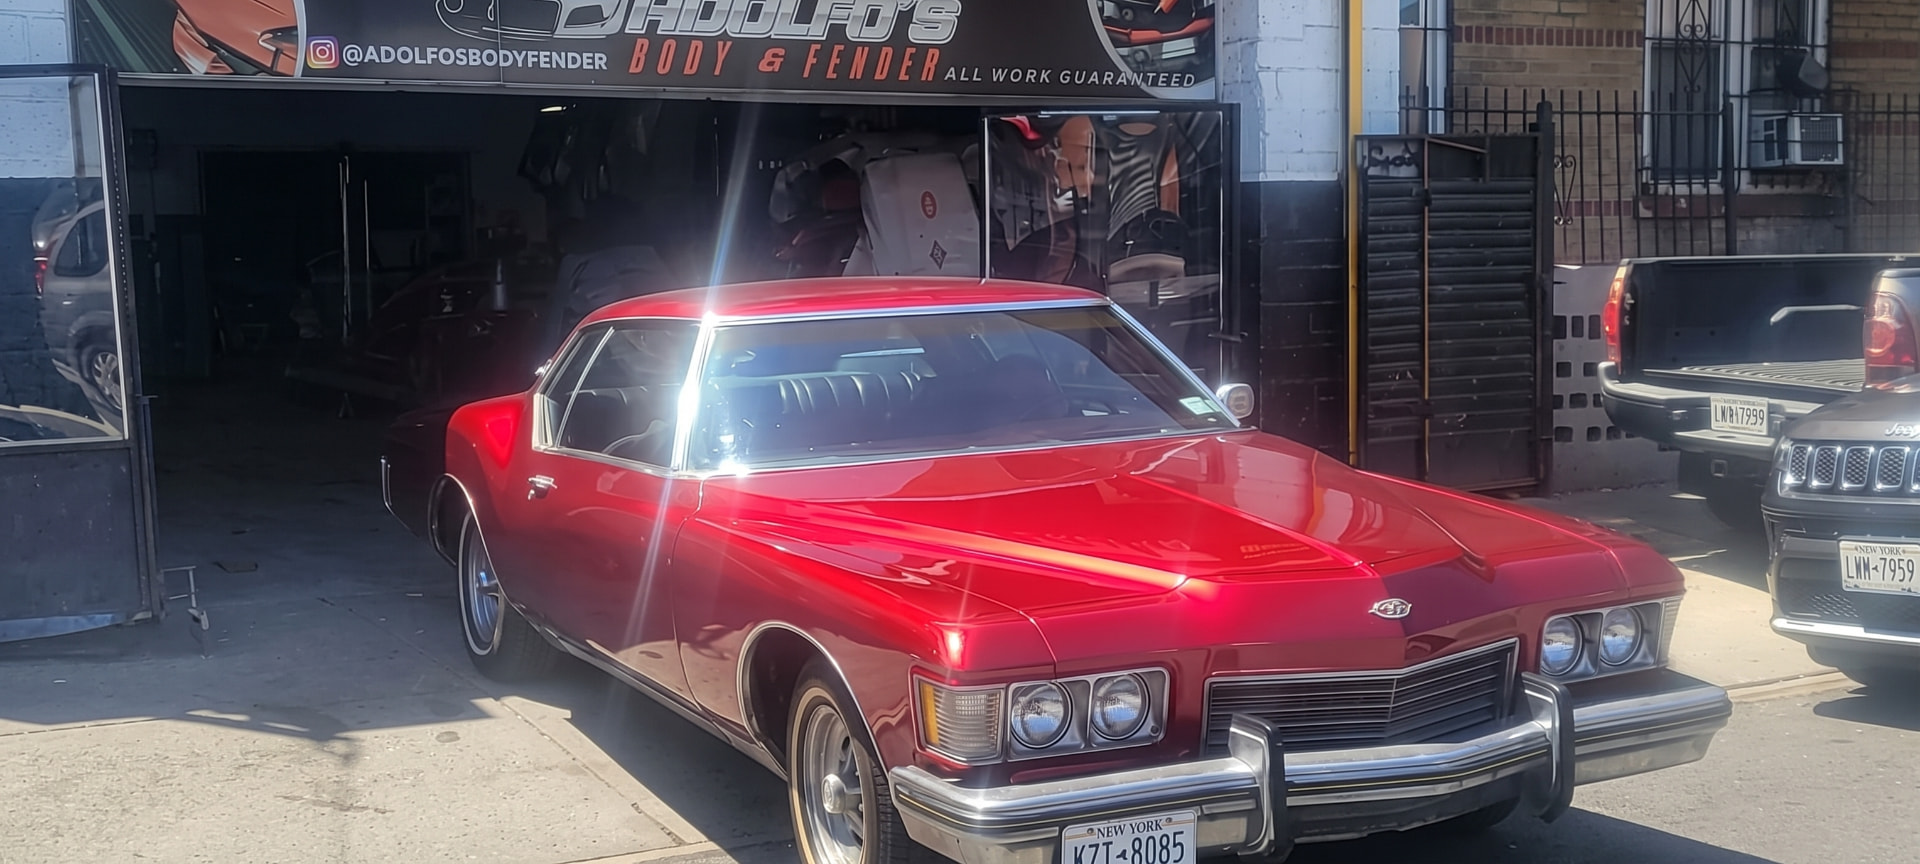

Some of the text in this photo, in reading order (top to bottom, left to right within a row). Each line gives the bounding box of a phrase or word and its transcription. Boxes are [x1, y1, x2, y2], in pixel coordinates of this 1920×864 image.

[624, 0, 962, 44] ADOLFO'S
[342, 44, 608, 70] @ADOLFOSBODYFENDER
[628, 38, 941, 81] BODY & FENDER
[944, 66, 1196, 88] ALL WORK GUARANTEED
[1858, 545, 1902, 556] NEW YORK
[1096, 819, 1163, 839] NEW YORK
[1130, 830, 1185, 864] 8085
